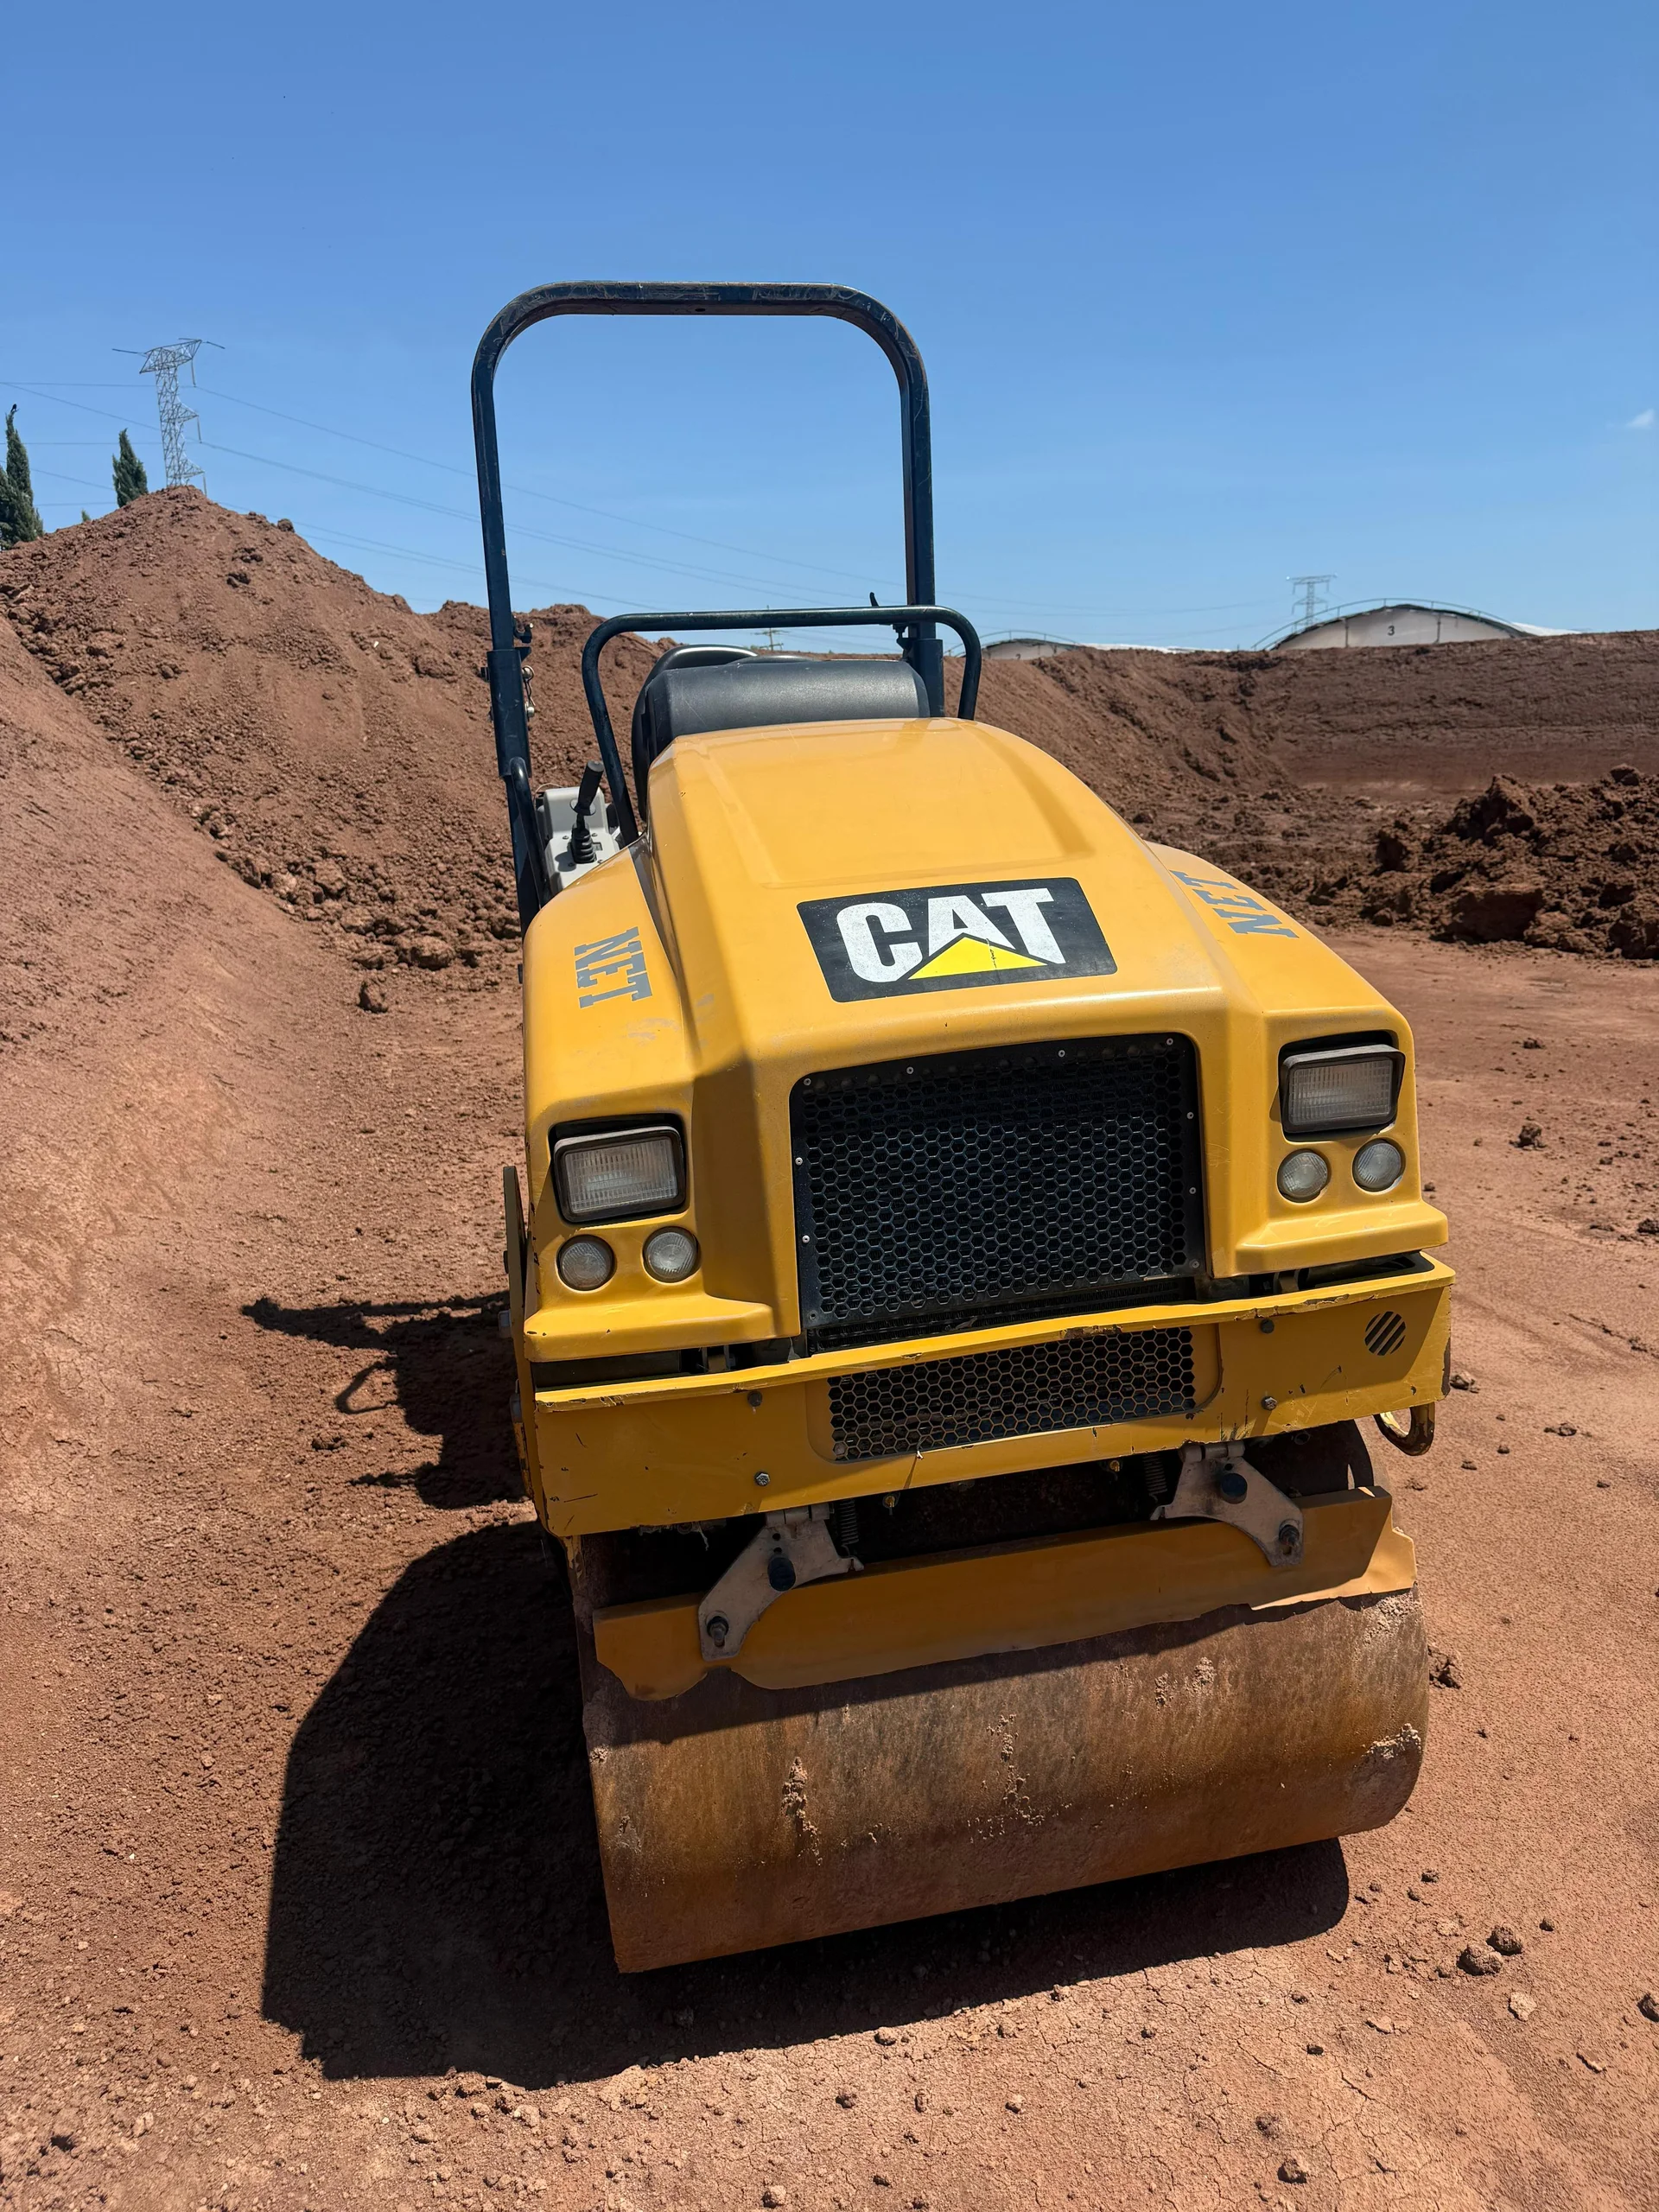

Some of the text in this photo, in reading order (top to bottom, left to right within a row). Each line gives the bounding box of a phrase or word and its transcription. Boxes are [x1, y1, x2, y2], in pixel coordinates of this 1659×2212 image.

[1387, 625, 1395, 636] 3
[836, 887, 1066, 983] CAT
[1169, 870, 1300, 938] NET
[575, 926, 652, 1008] NET
